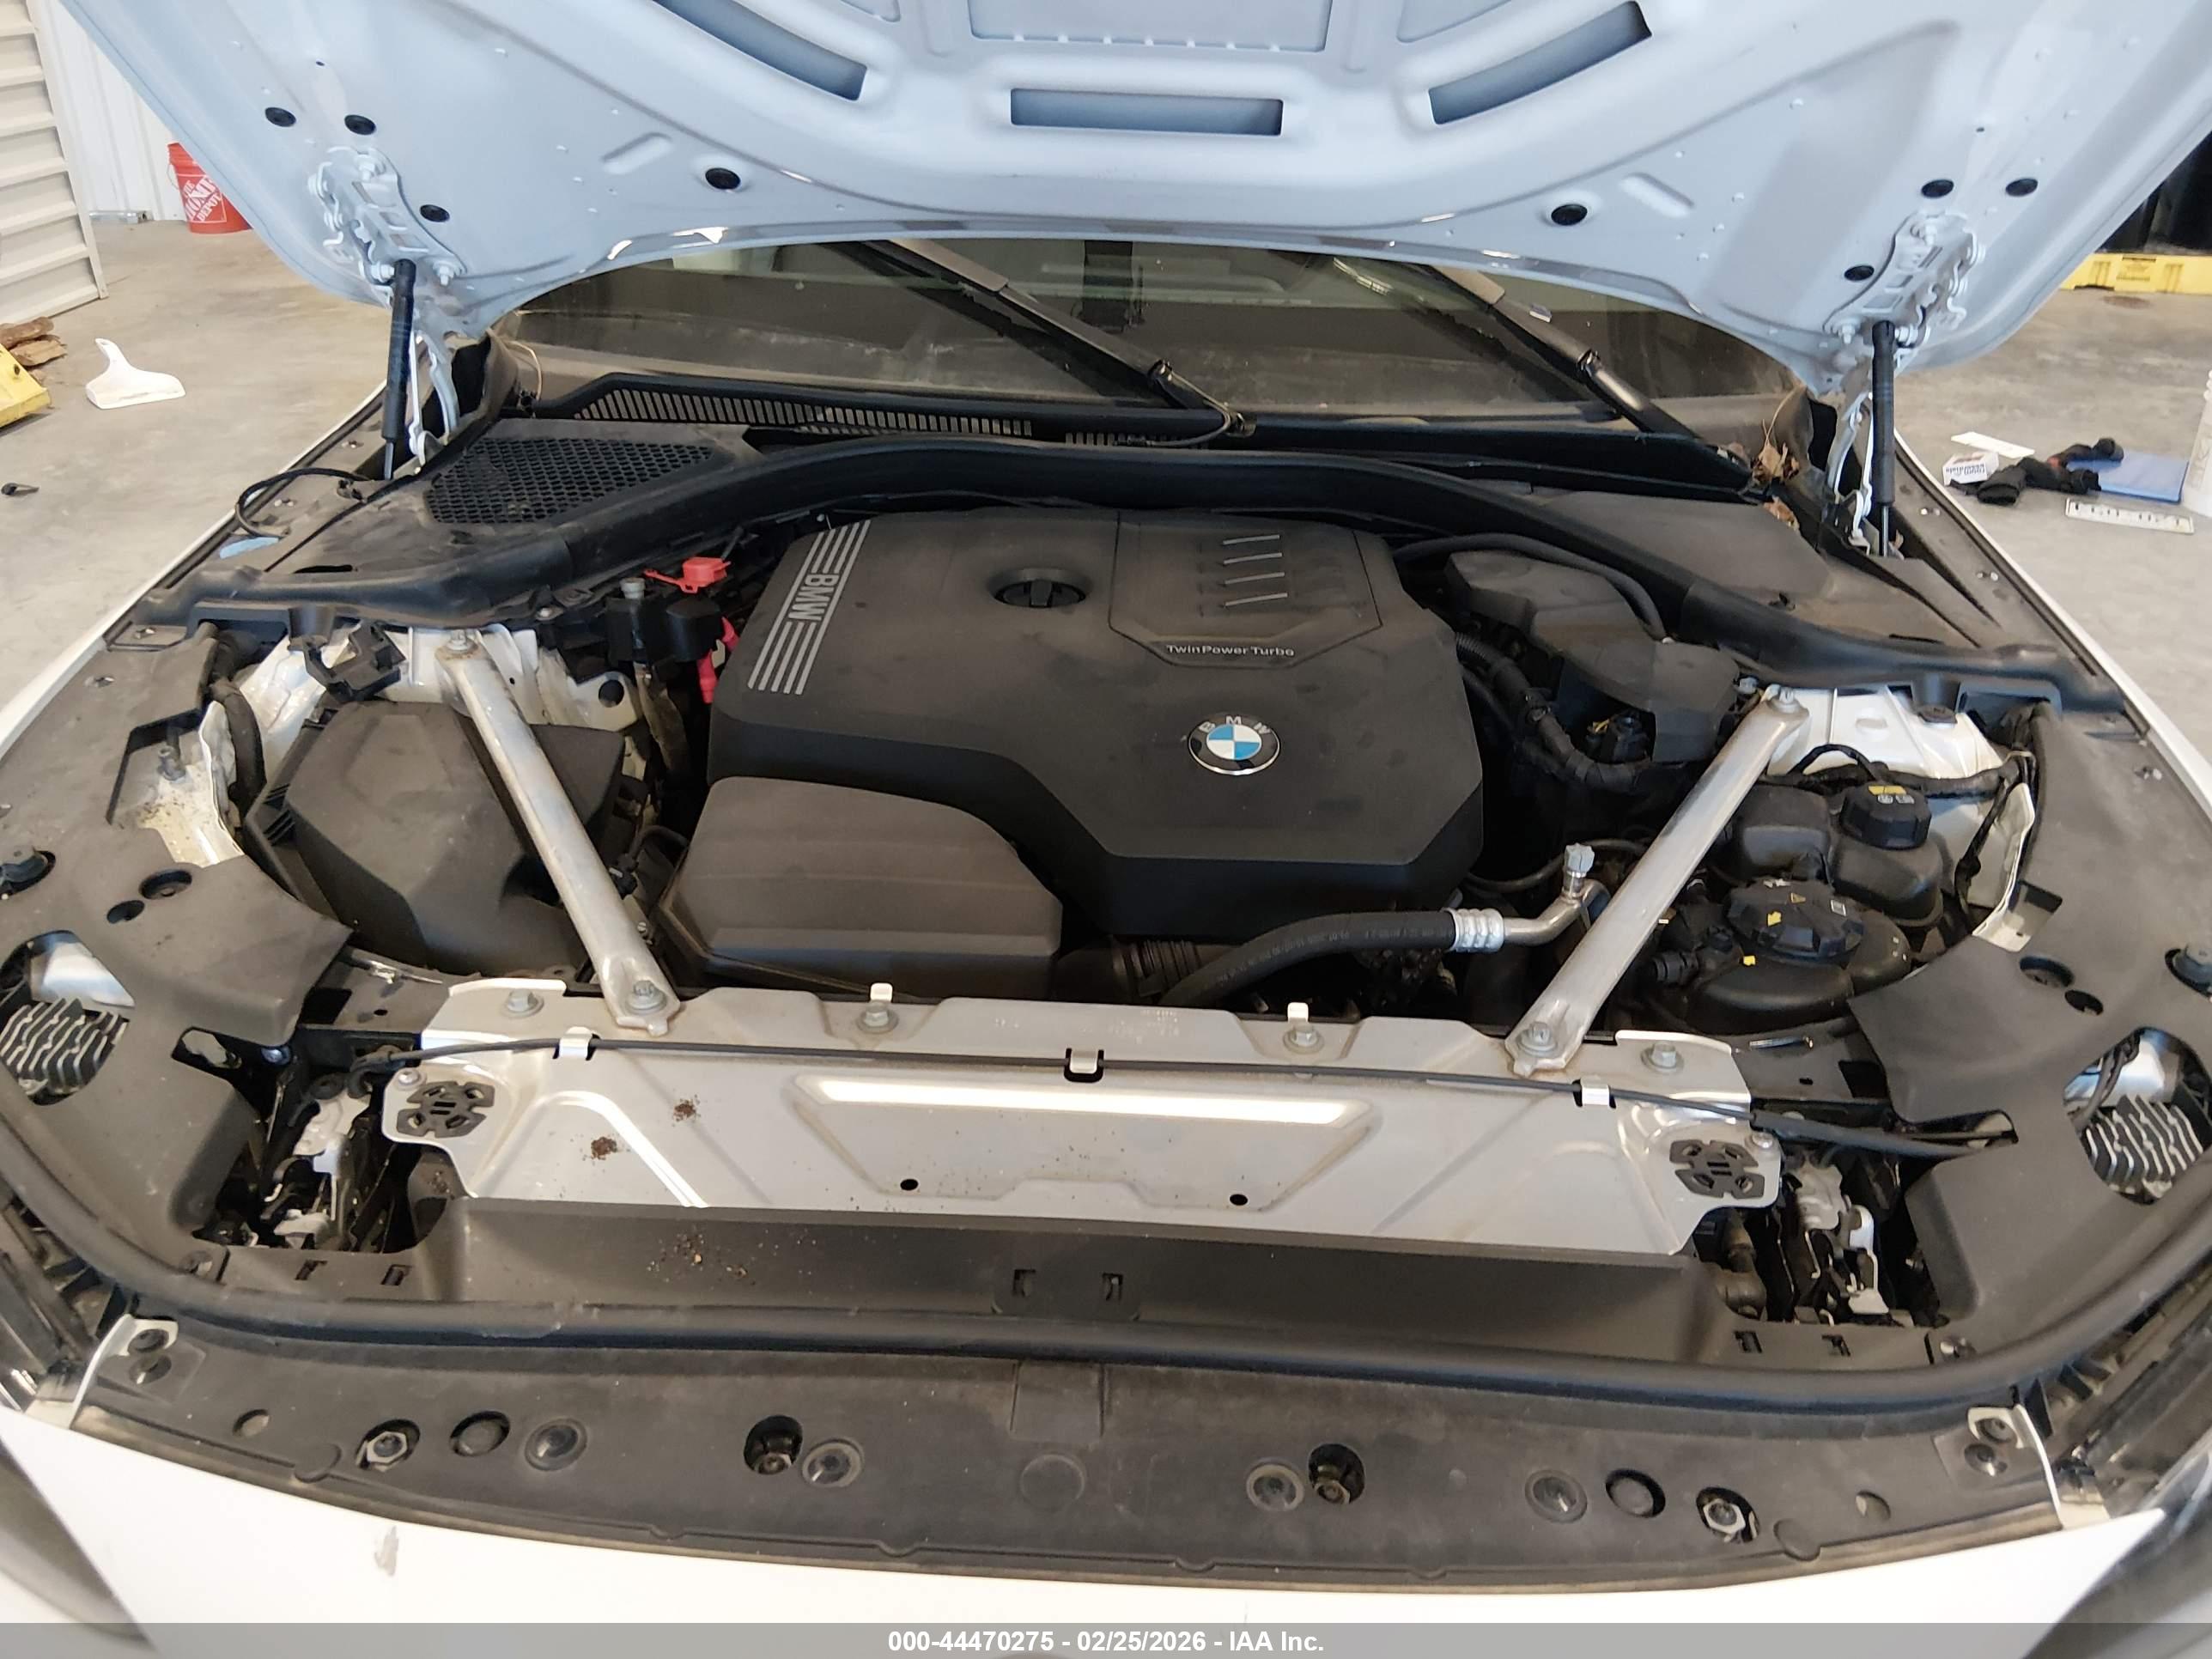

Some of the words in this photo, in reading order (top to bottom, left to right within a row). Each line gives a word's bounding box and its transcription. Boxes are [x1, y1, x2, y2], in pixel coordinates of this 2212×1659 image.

[197, 192, 221, 222] DEPOT
[787, 574, 840, 622] BMW
[1166, 644, 1249, 655] TwinPower
[1250, 645, 1295, 656] Turbo
[1198, 715, 1271, 734] BMW
